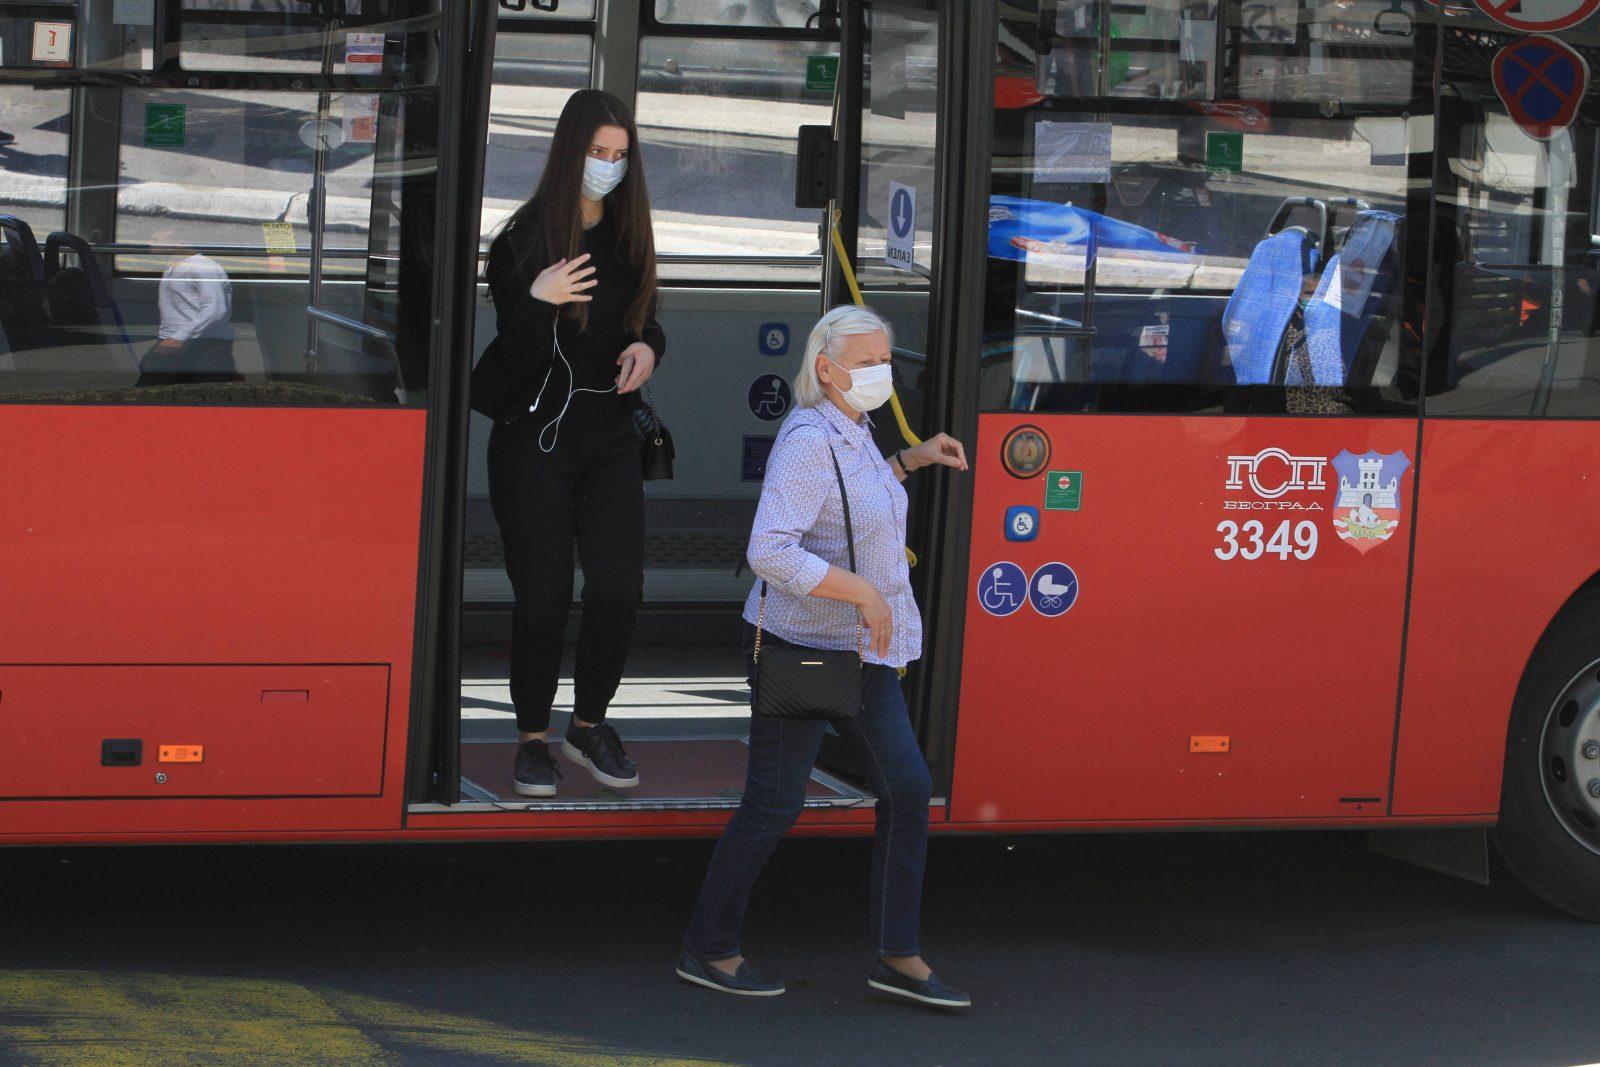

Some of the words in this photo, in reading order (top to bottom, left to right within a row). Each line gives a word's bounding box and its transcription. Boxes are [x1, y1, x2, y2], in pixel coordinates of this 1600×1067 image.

[887, 247, 911, 263] ИЗЛАЗ
[1225, 447, 1328, 499] ГСП
[1223, 500, 1324, 511] БЕОГРАД
[1214, 519, 1319, 561] 3349
